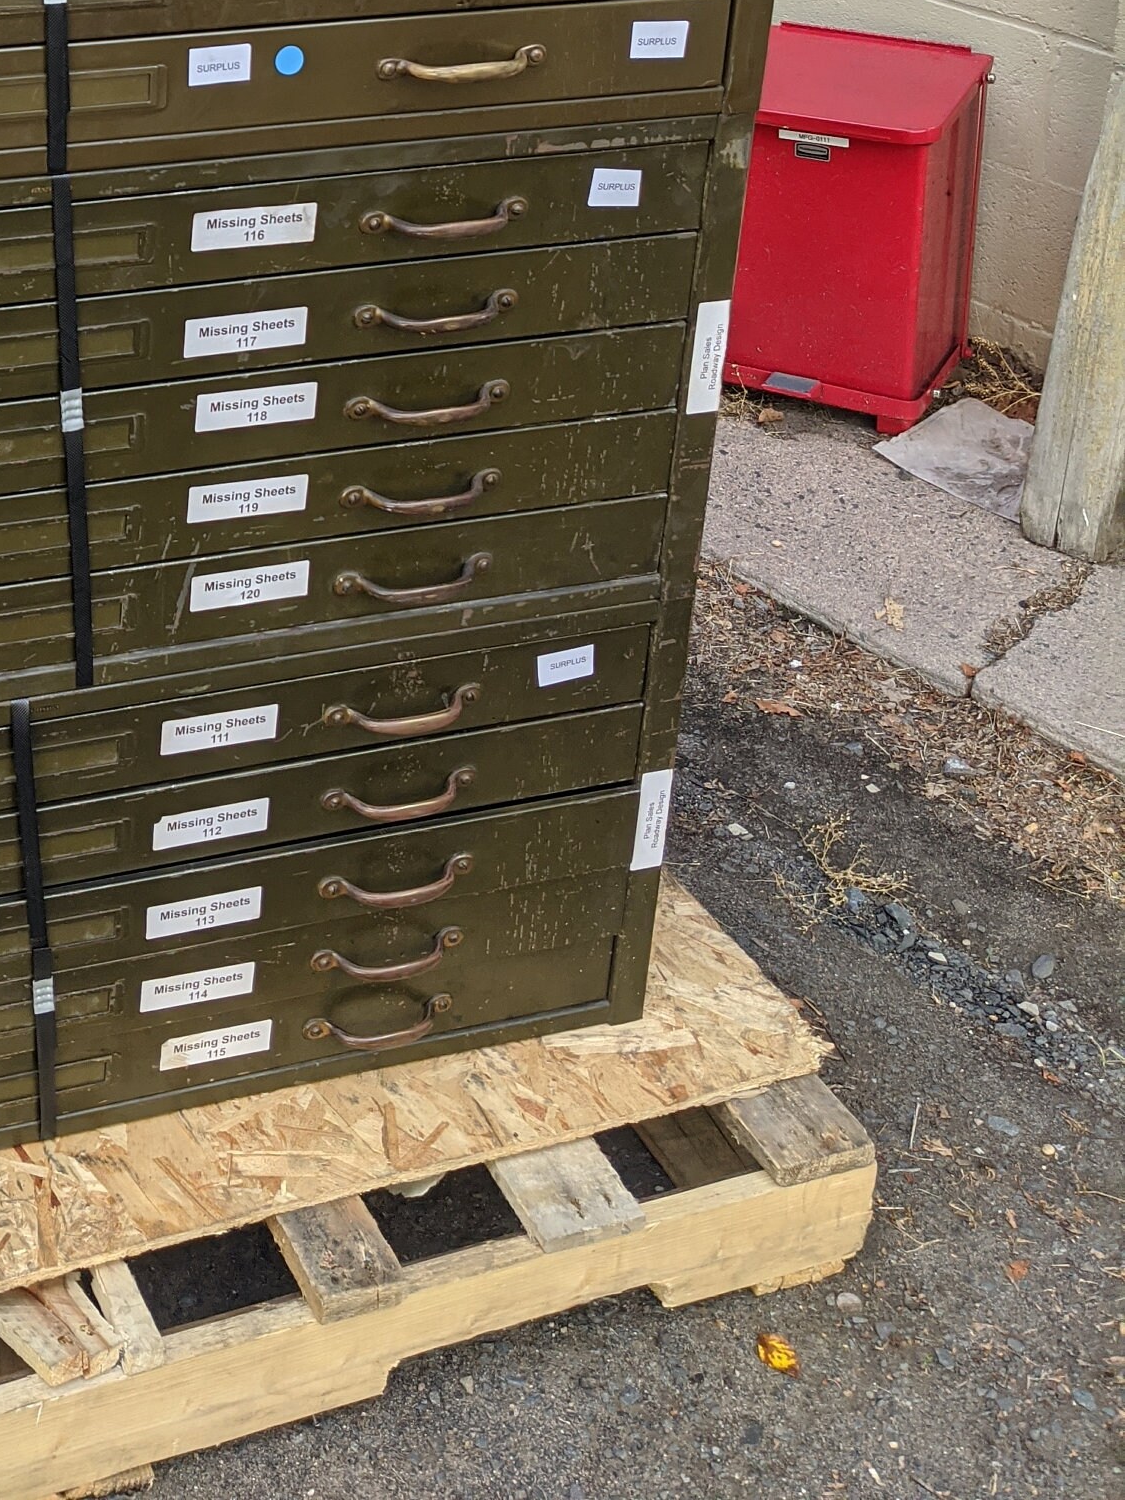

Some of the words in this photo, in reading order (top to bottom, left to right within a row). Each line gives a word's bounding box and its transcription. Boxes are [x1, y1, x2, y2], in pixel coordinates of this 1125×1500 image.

[637, 35, 678, 47] SURPLUS
[196, 60, 241, 74] SURPLUS
[597, 182, 636, 192] SURPLUS
[206, 214, 256, 232] Missing
[260, 211, 304, 226] Sheets
[242, 229, 266, 241] 116
[198, 321, 249, 339] Missing
[252, 317, 296, 333] Sheets
[235, 336, 257, 348] 117
[714, 324, 724, 351] Design
[703, 337, 712, 359] Sales
[700, 361, 709, 379] Plan
[708, 354, 721, 390] Roadway
[209, 396, 259, 413] Missing
[263, 392, 306, 407] Sheets
[245, 410, 268, 422] 118
[202, 489, 250, 505] Missing
[254, 484, 297, 499] Sheets
[237, 501, 260, 513] 119
[204, 575, 252, 591] Missing
[256, 569, 297, 584] Sheets
[239, 588, 261, 599] 120
[549, 656, 587, 671] SURPLUS
[175, 719, 223, 736] Missing
[226, 714, 267, 728] Sheets
[209, 732, 231, 744] 111
[645, 802, 655, 819] Sales
[656, 789, 665, 816] Design
[167, 814, 214, 832] Missing
[217, 807, 258, 822] Sheets
[201, 826, 223, 838] 112
[643, 821, 654, 840] Plan
[651, 814, 663, 849] Roadway
[160, 903, 206, 921] Missing
[209, 896, 251, 912] Sheets
[195, 914, 215, 926] 113
[154, 978, 200, 996] Missing
[202, 971, 244, 987] Sheets
[188, 989, 208, 1001] 114
[173, 1037, 218, 1054] Missing
[221, 1029, 261, 1045] Sheets
[206, 1047, 227, 1058] 115
